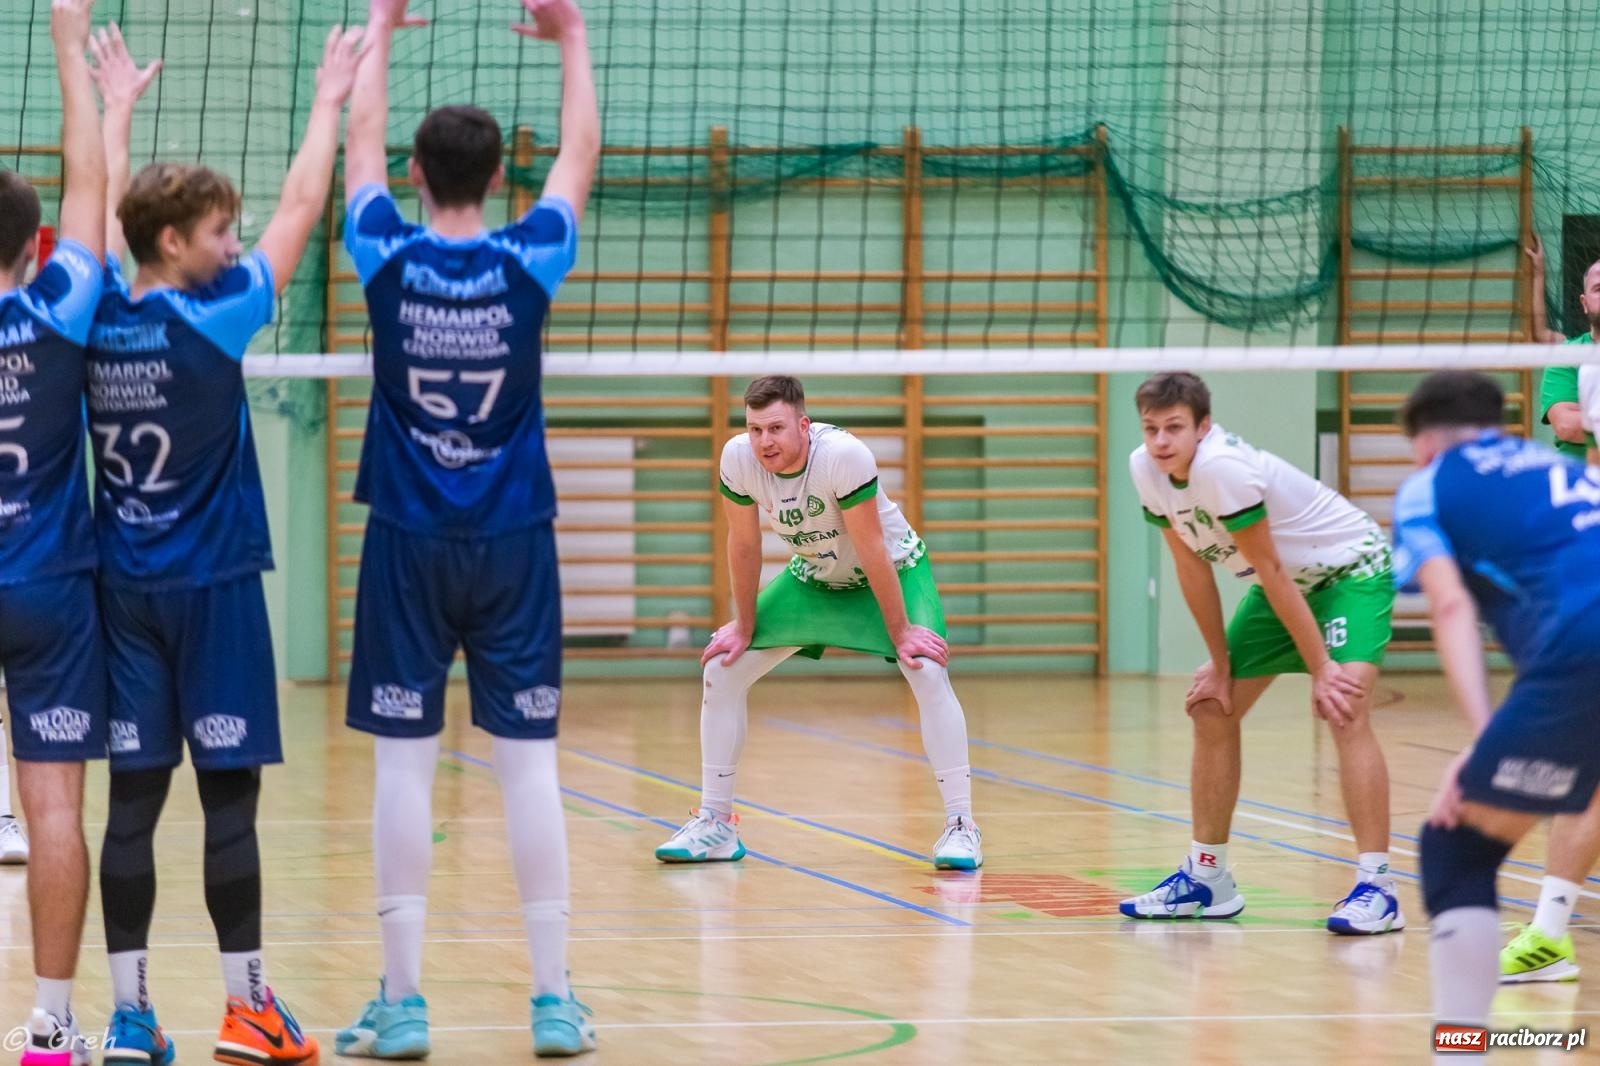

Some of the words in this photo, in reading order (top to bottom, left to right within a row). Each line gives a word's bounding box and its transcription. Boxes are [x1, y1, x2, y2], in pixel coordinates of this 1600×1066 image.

[87, 360, 173, 380] MARPOL
[407, 367, 506, 421] 57
[92, 422, 179, 493] 32
[778, 508, 804, 527] 49
[1199, 852, 1217, 866] R
